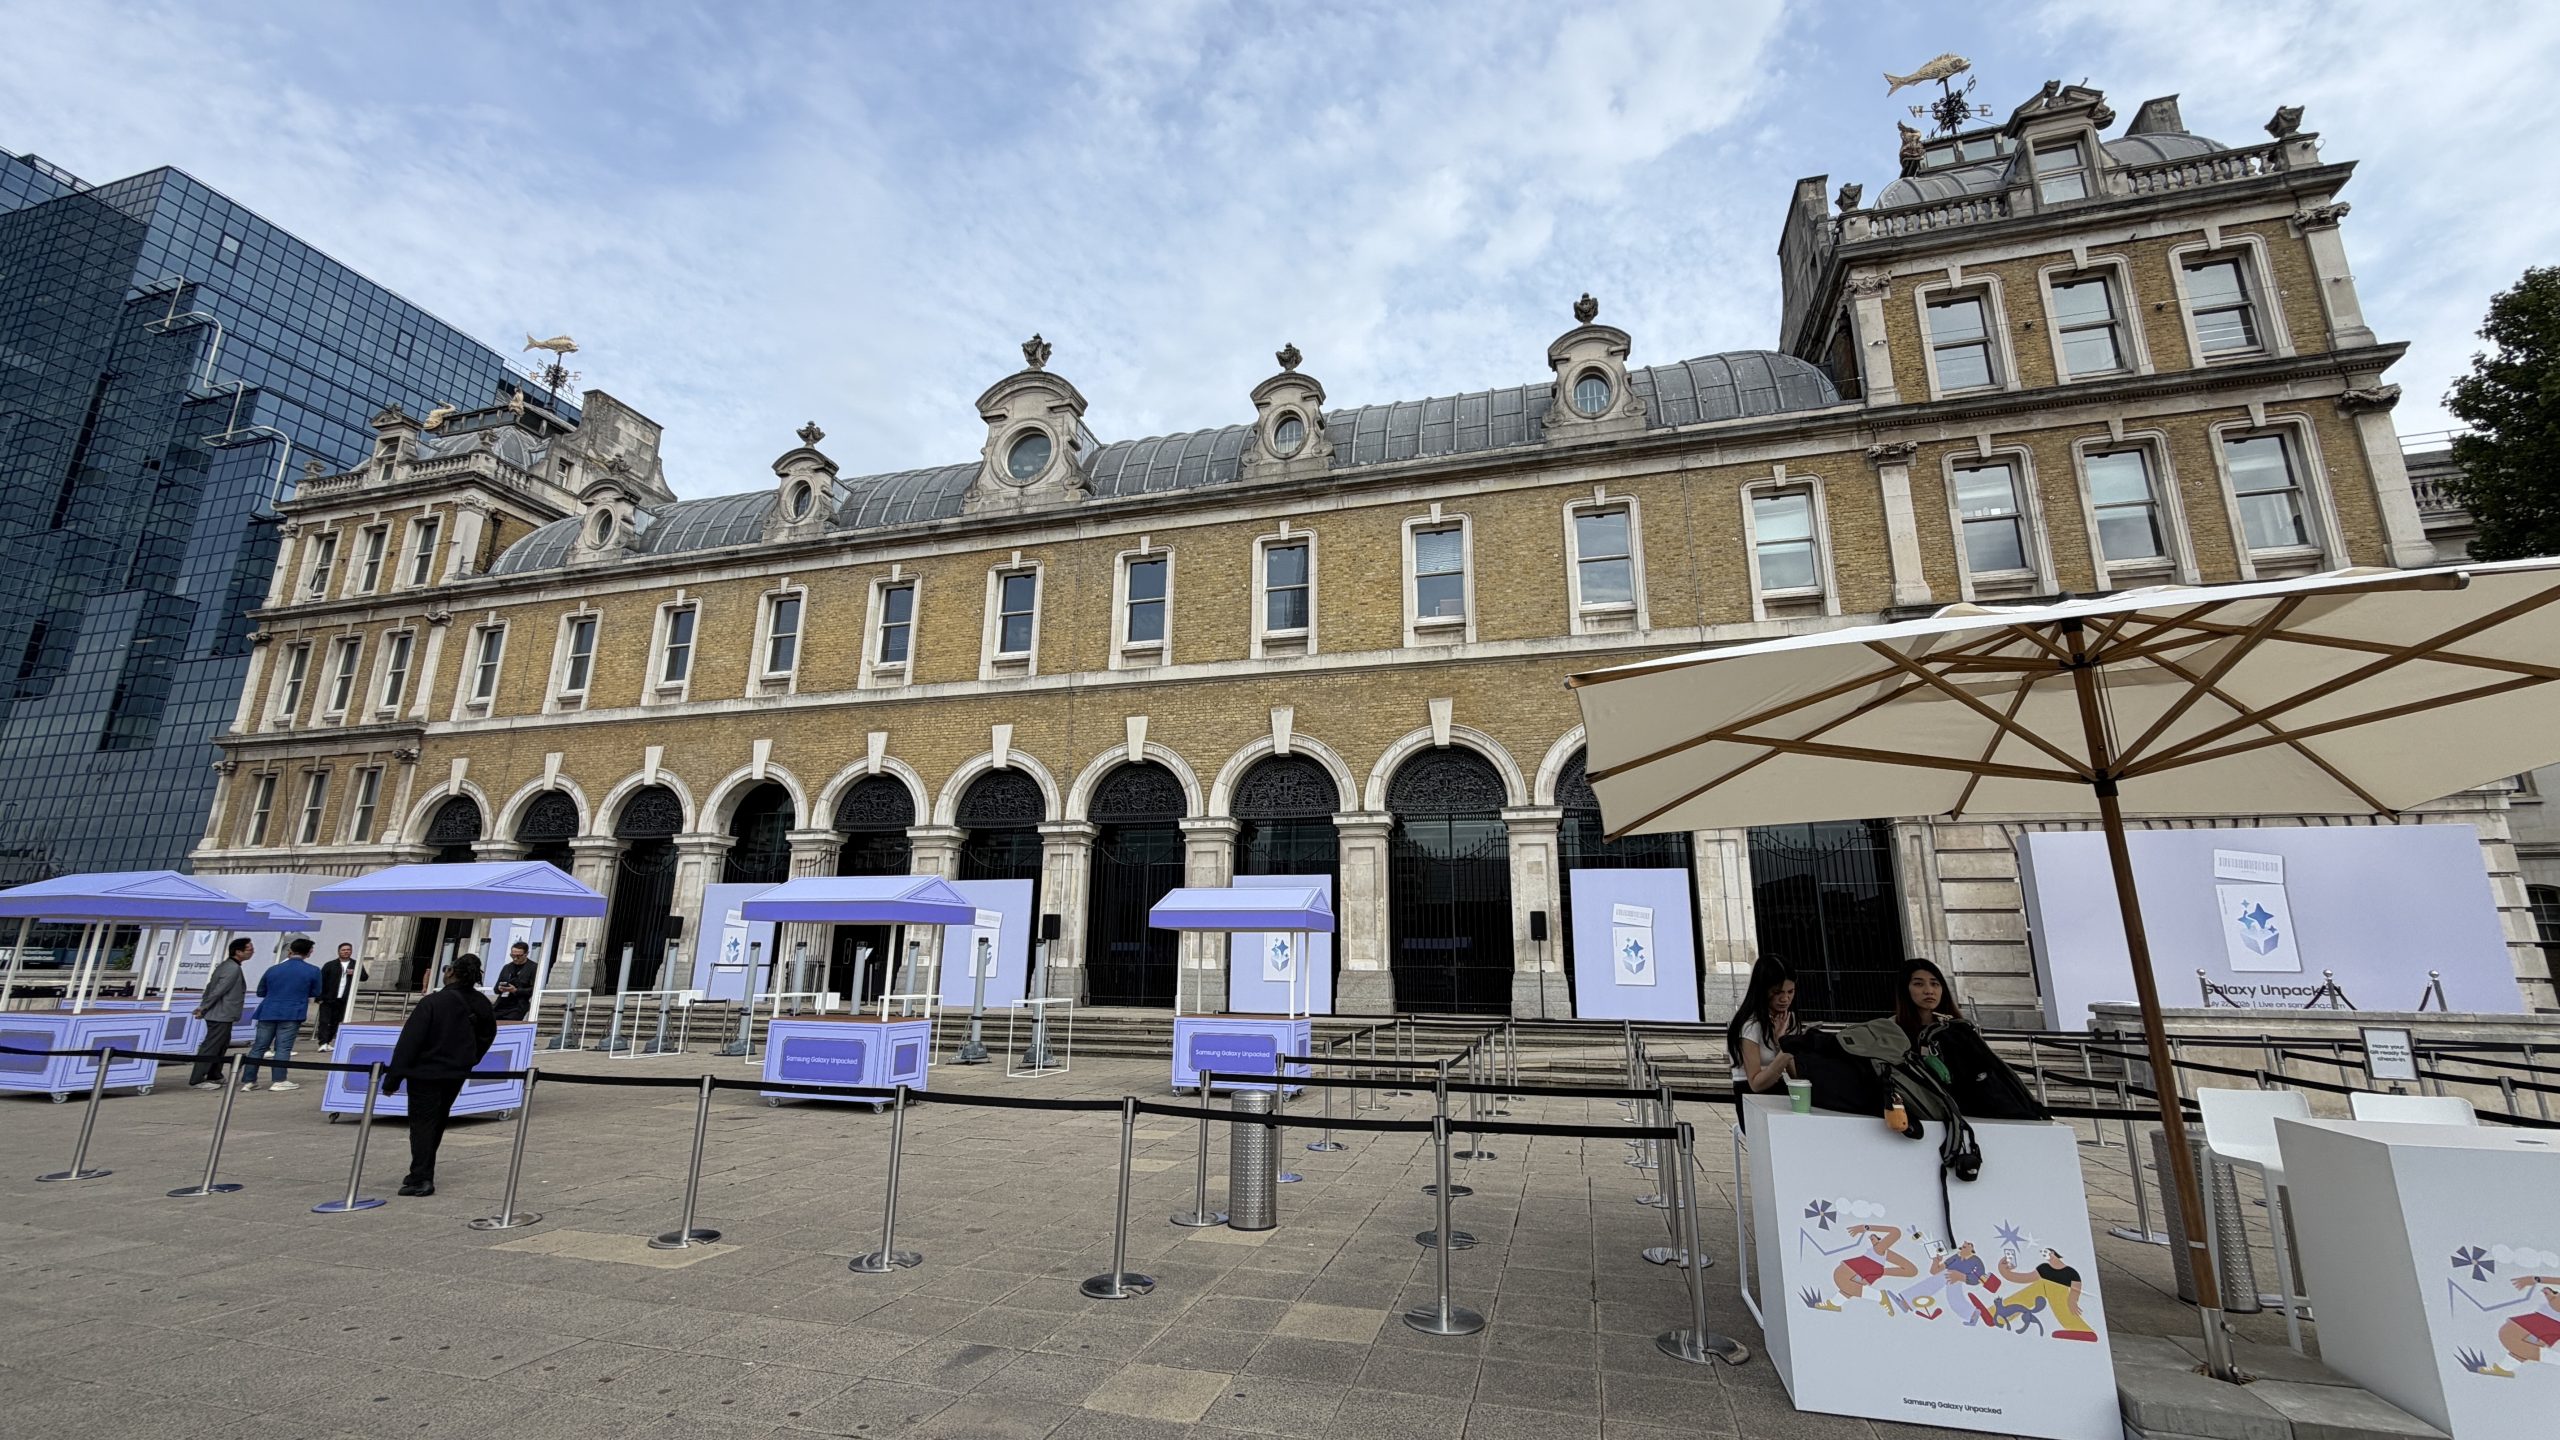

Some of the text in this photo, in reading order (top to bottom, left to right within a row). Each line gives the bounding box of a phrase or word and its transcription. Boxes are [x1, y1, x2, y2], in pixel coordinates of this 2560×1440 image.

[1979, 104, 1993, 117] E
[1195, 1049, 1270, 1059] Samsung Galaxy Unpacked
[786, 1055, 858, 1066] Samsung Galaxy Unpacked
[1903, 1397, 2002, 1415] Samsung Galaxy Unpacked
